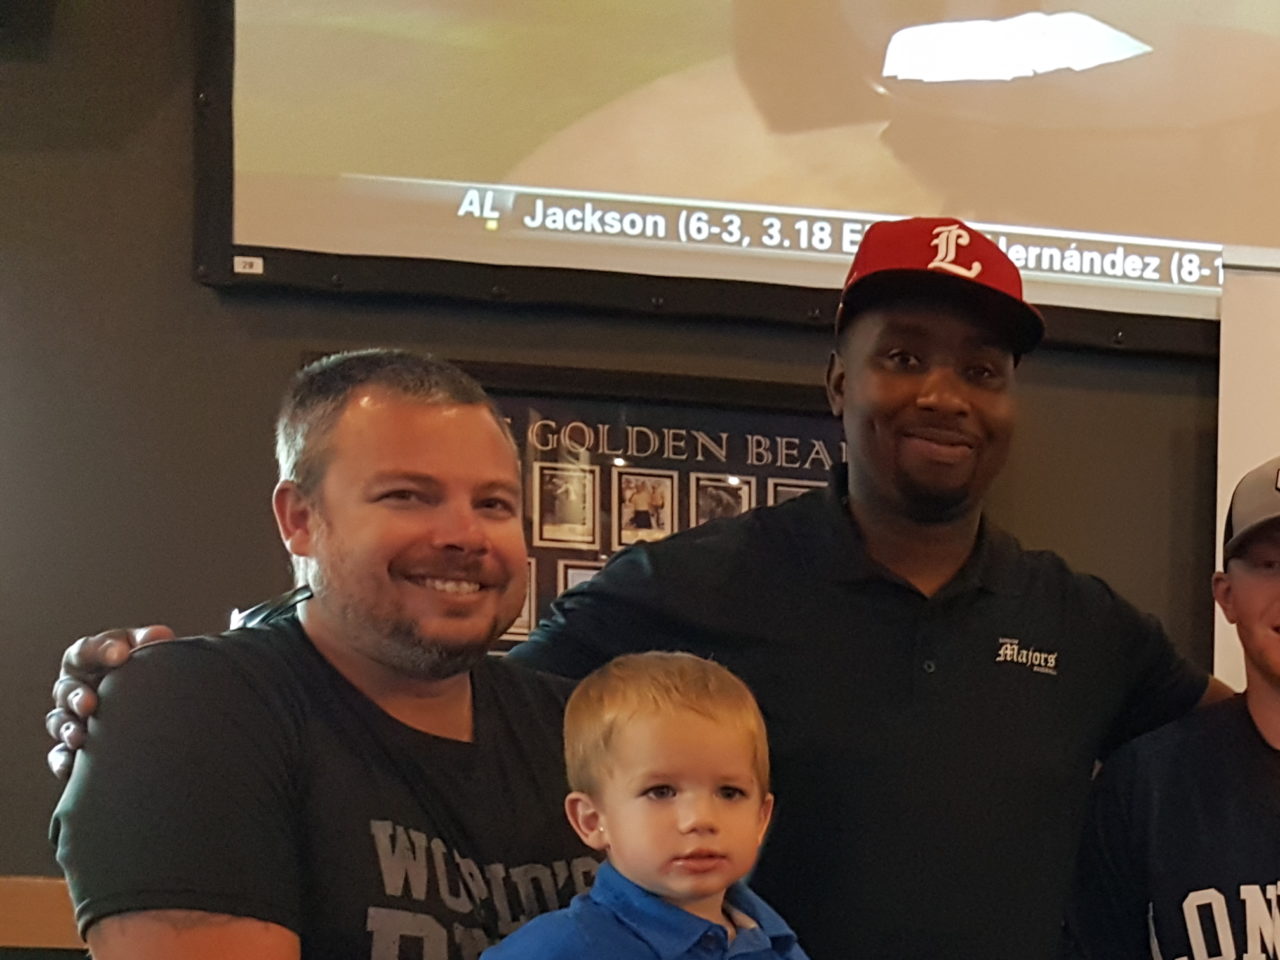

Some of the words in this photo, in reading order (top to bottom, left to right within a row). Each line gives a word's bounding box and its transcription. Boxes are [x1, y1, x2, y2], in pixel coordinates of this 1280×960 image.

[457, 190, 499, 218] AL
[523, 199, 666, 239] Jackson
[678, 210, 751, 249] (6-3,
[761, 217, 832, 251] 3.18
[842, 222, 864, 254] E
[1000, 234, 1160, 280] ernández
[528, 420, 729, 464] GOLDEN
[745, 433, 847, 471] BEA
[995, 643, 1058, 668] Majors
